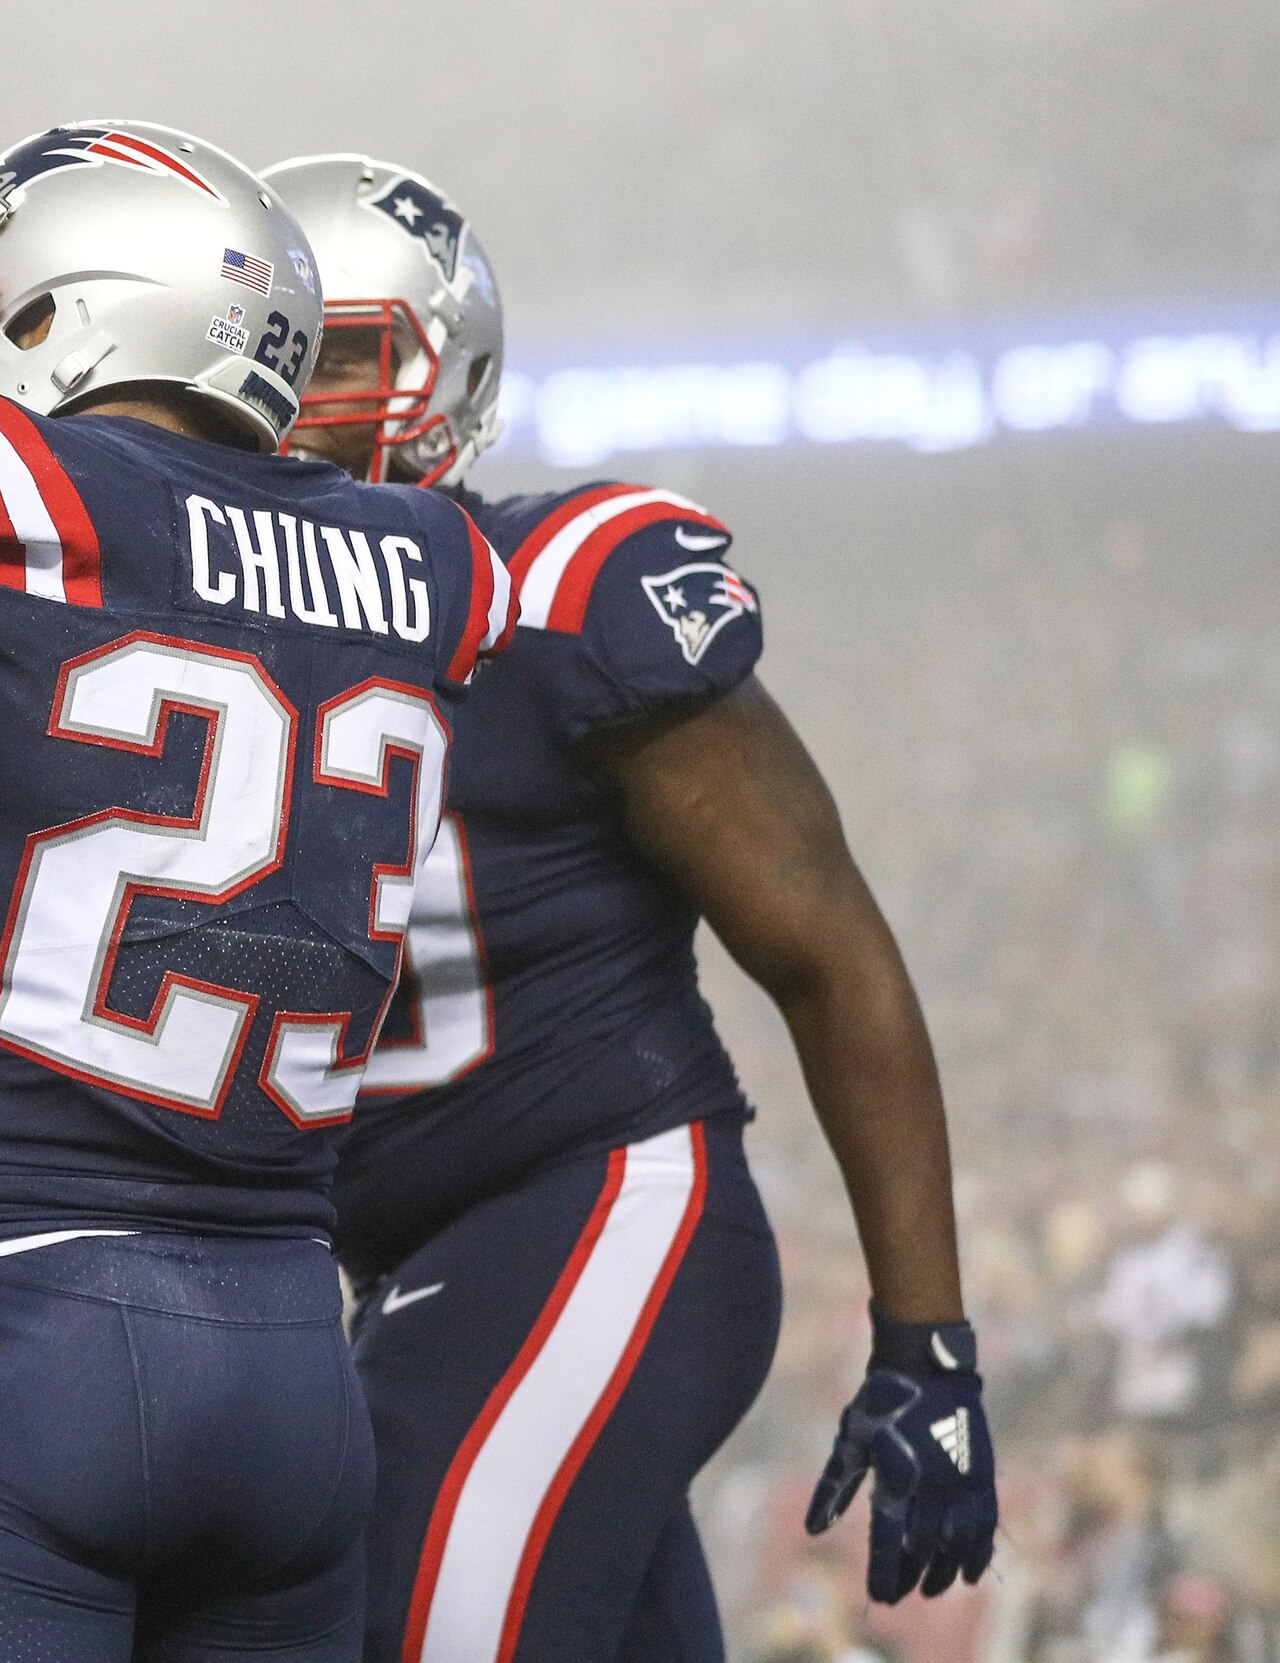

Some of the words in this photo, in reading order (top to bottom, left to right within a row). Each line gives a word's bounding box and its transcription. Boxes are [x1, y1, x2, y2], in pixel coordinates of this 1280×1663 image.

[209, 327, 245, 350] CATCH
[213, 318, 246, 340] CRUCIAL
[254, 310, 308, 386] 23
[185, 493, 431, 643] CHUNG
